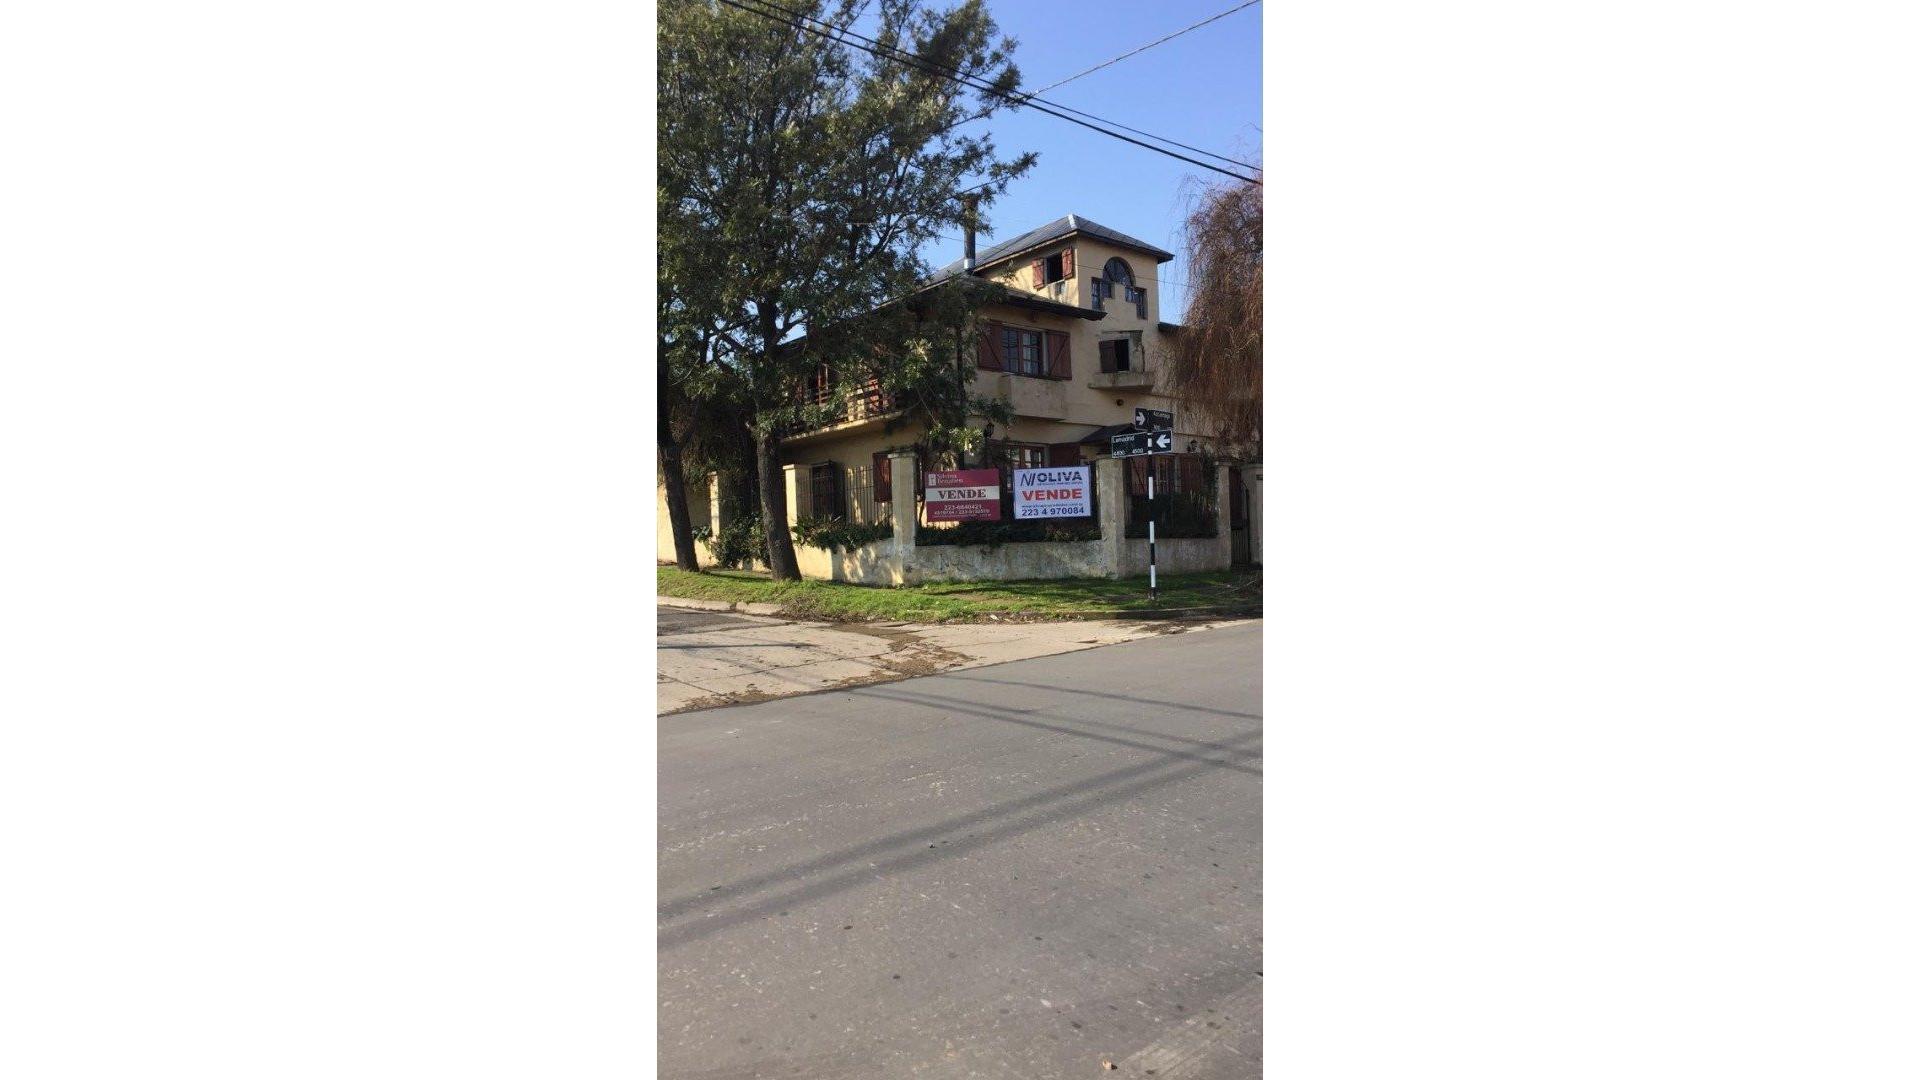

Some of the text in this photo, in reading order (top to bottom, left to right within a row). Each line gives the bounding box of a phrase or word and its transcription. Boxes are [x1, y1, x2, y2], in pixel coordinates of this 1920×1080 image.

[1037, 470, 1083, 482] OLIVA
[938, 489, 987, 499] VENDE
[1022, 488, 1083, 501] VENDE
[1022, 508, 1039, 516] 223
[1050, 506, 1085, 515] 970084
